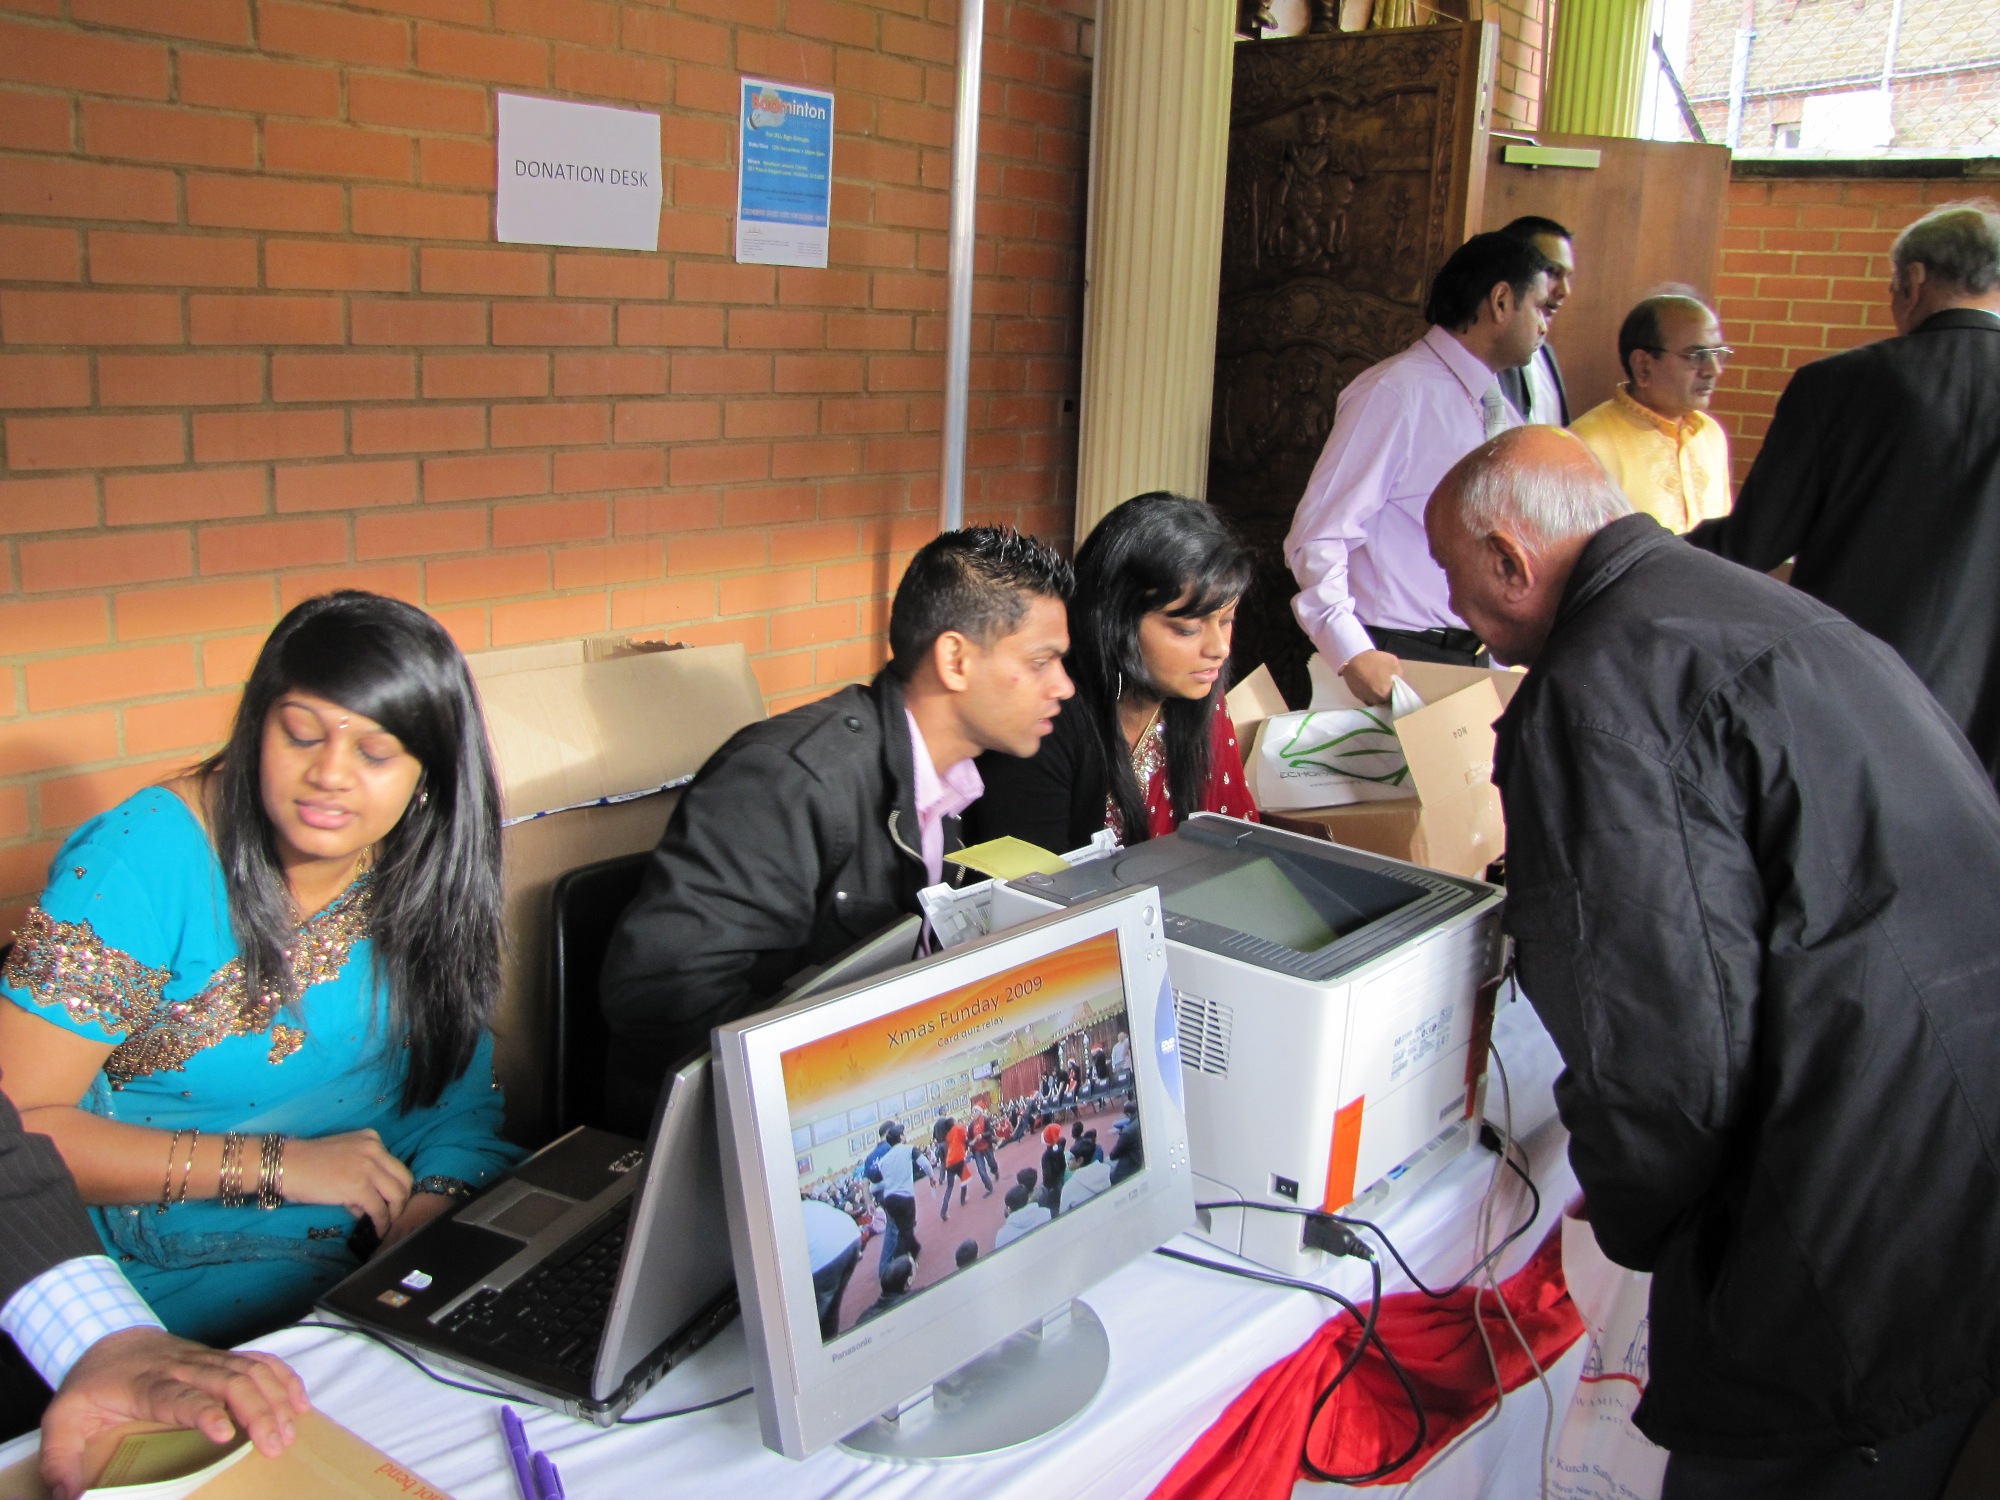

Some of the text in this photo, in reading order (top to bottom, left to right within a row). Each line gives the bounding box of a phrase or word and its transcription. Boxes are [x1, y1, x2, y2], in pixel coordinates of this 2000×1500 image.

[750, 93, 826, 120] Badminton
[515, 159, 648, 188] DONATION DESK
[887, 975, 1043, 1049] Xmas Funday 2009
[937, 1015, 1005, 1048] Card quiz relay
[832, 1336, 873, 1363] Panasonic
[373, 1462, 418, 1493] bend
